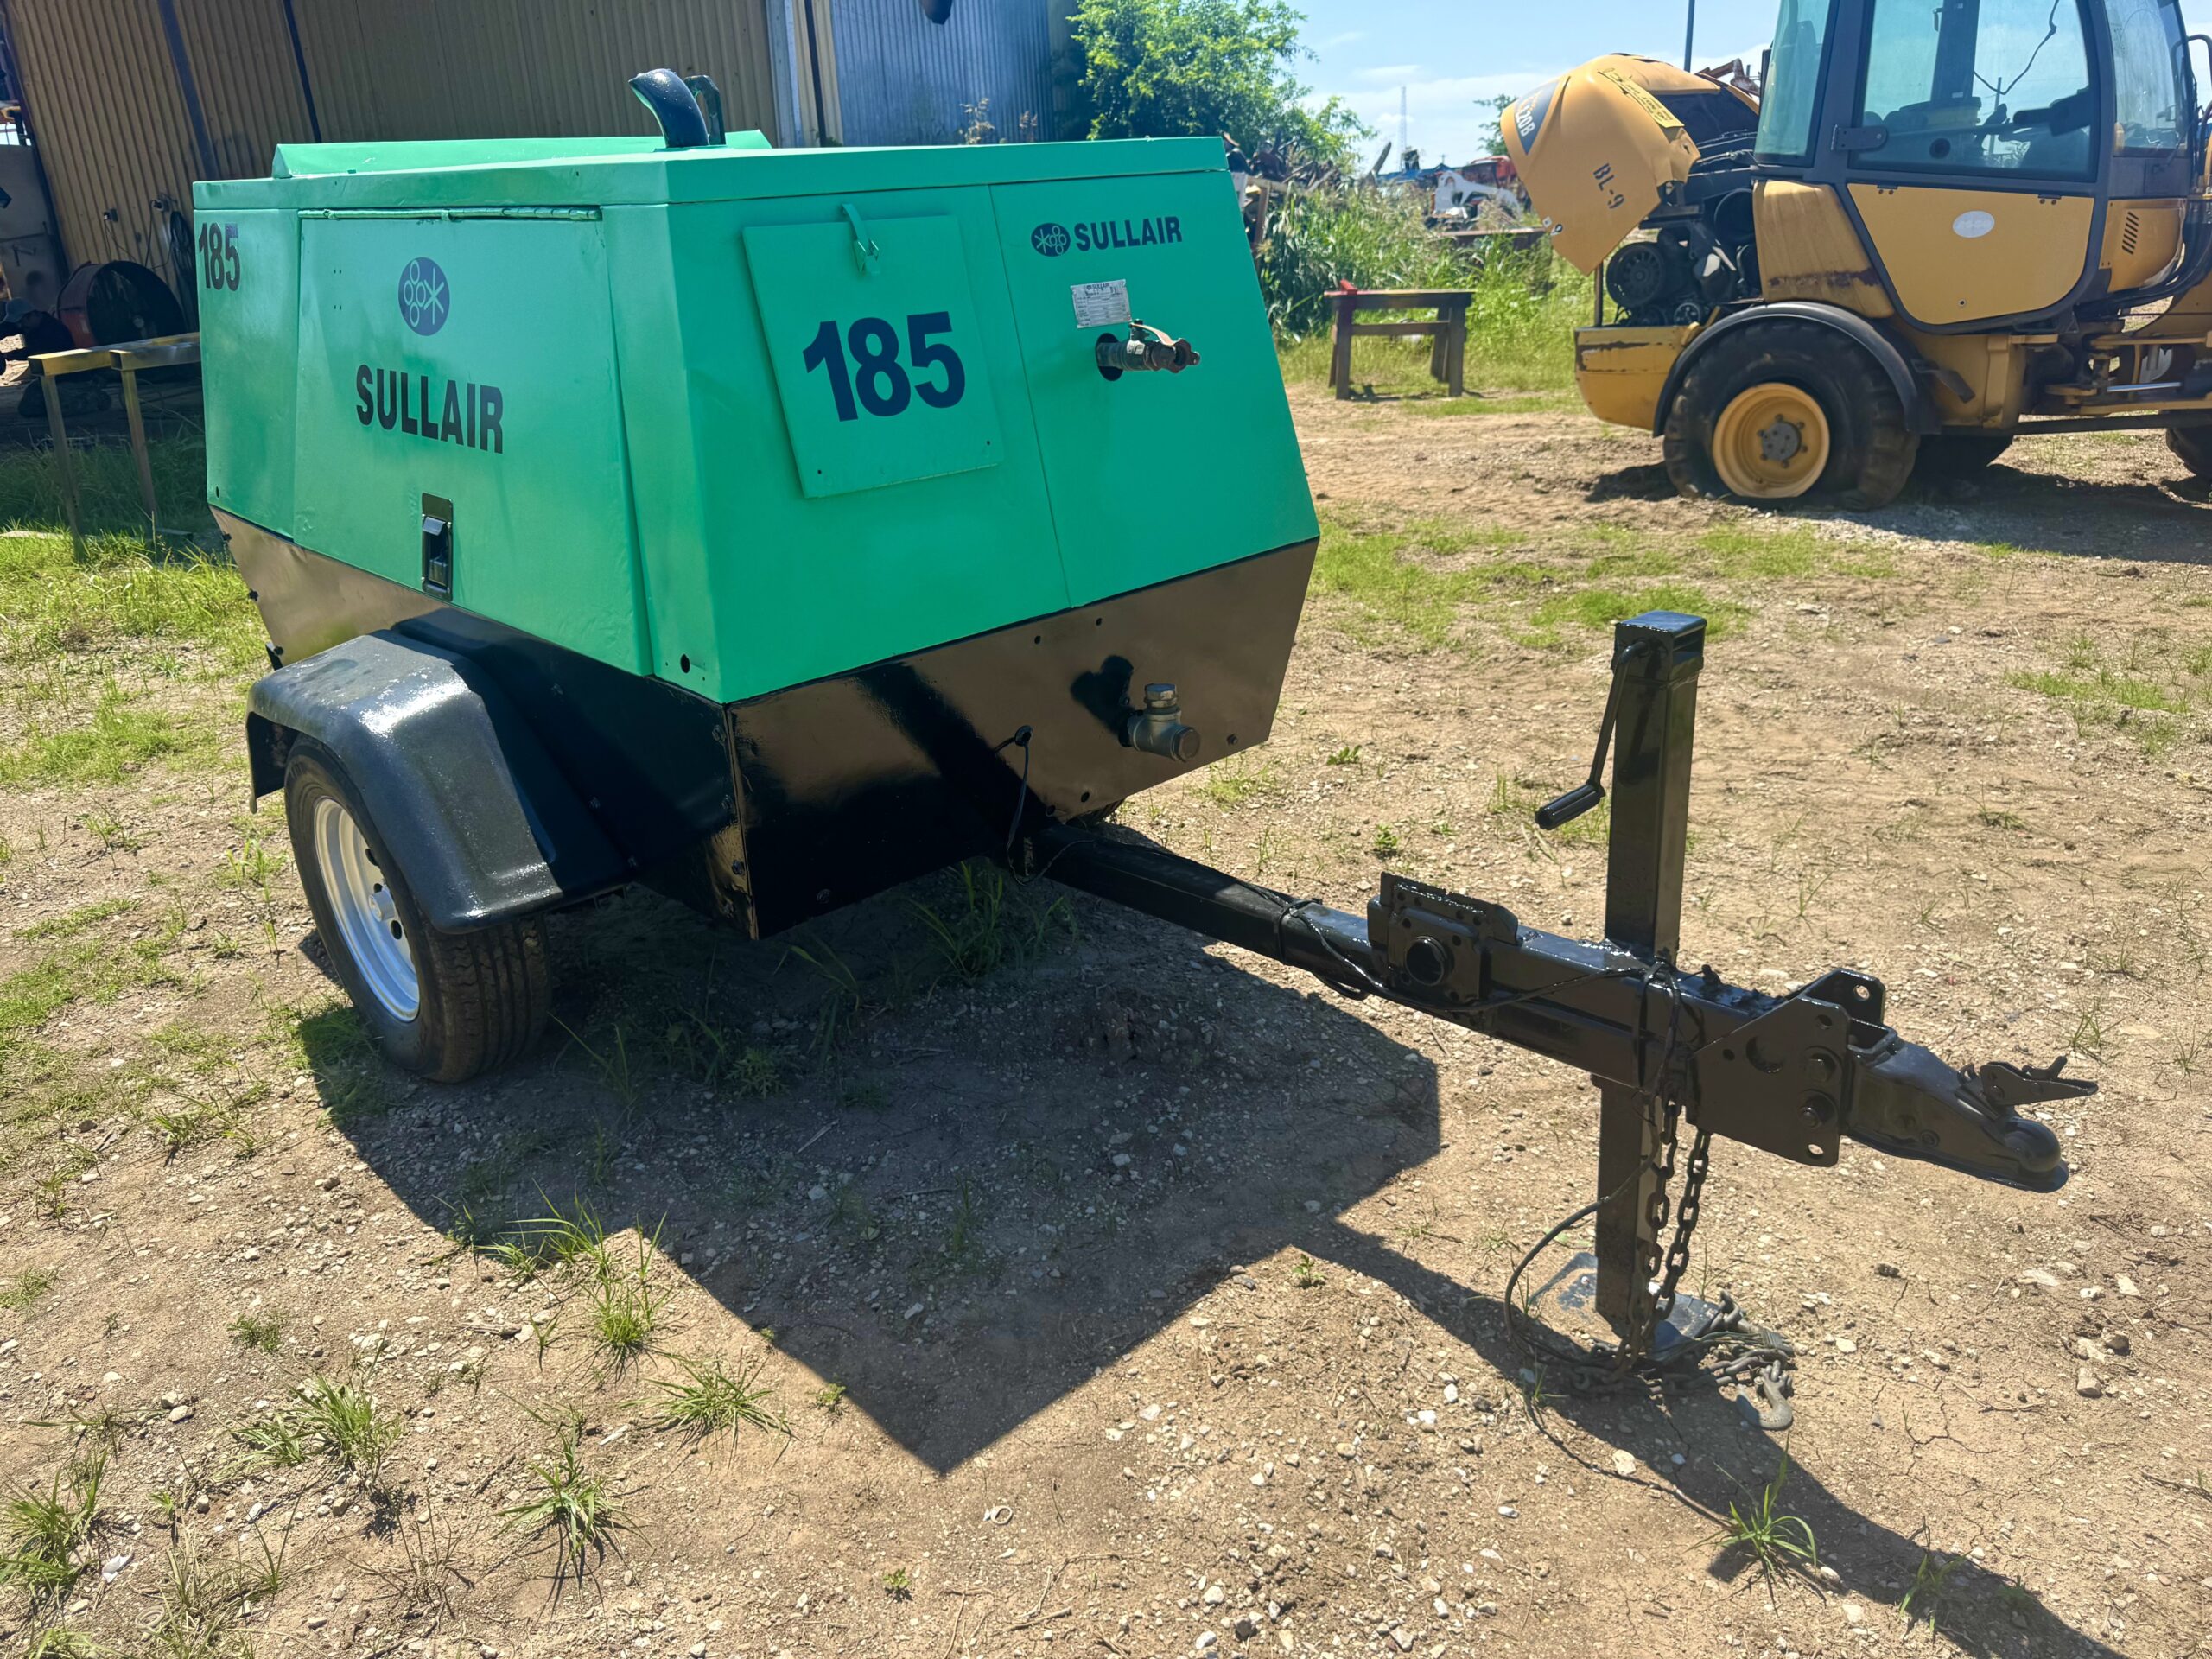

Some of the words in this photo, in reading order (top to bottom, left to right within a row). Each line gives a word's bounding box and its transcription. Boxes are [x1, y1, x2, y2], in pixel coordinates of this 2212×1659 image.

[1592, 163, 1625, 209] BL-9
[198, 221, 241, 291] 185
[1074, 216, 1183, 252] SULLAIR
[803, 311, 966, 422] 185
[356, 364, 504, 454] SULLAIR
